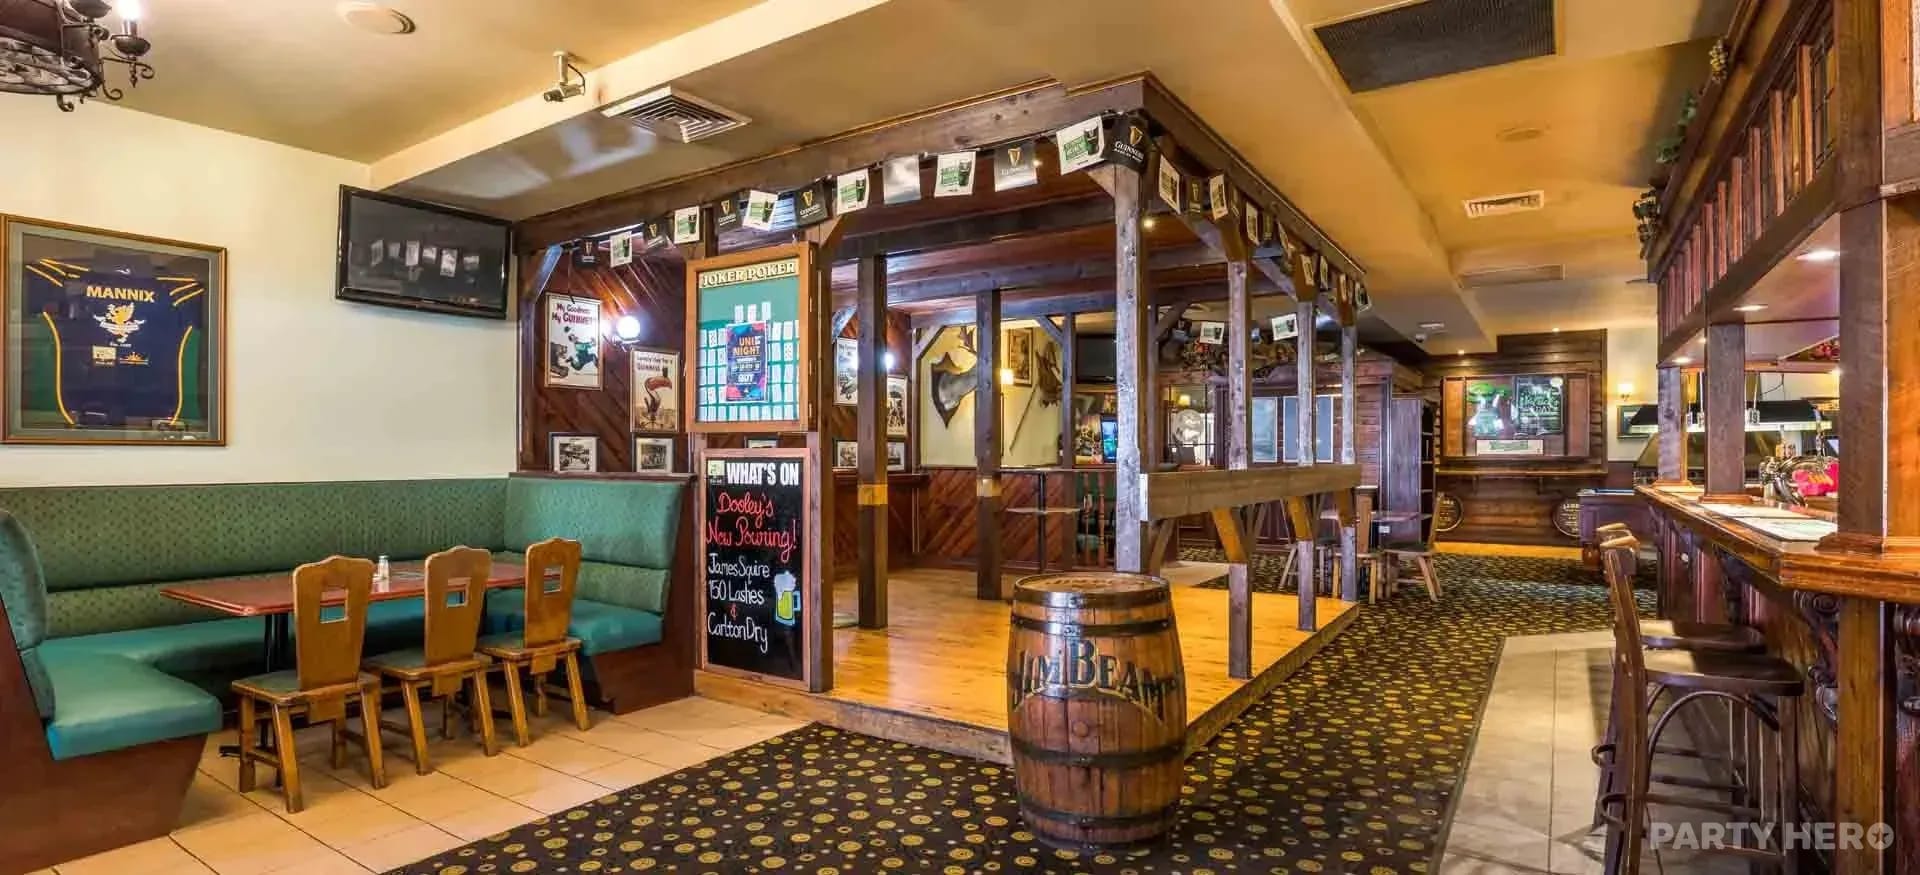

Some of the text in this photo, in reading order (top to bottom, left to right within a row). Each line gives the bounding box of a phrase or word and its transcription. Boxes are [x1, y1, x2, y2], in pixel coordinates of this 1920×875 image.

[703, 262, 797, 286] JOKER POKER
[86, 285, 155, 303] MANNIX
[734, 345, 760, 356] NIGHT
[726, 462, 777, 486] WHAT'S
[780, 462, 800, 486] ON
[716, 491, 774, 528] Dooley's
[706, 516, 797, 563] Now Pouring!
[708, 552, 770, 585] James Squire
[709, 579, 765, 605] 150 Lashes
[707, 611, 768, 653] Carlton Dry
[1067, 637, 1178, 724] BEAM
